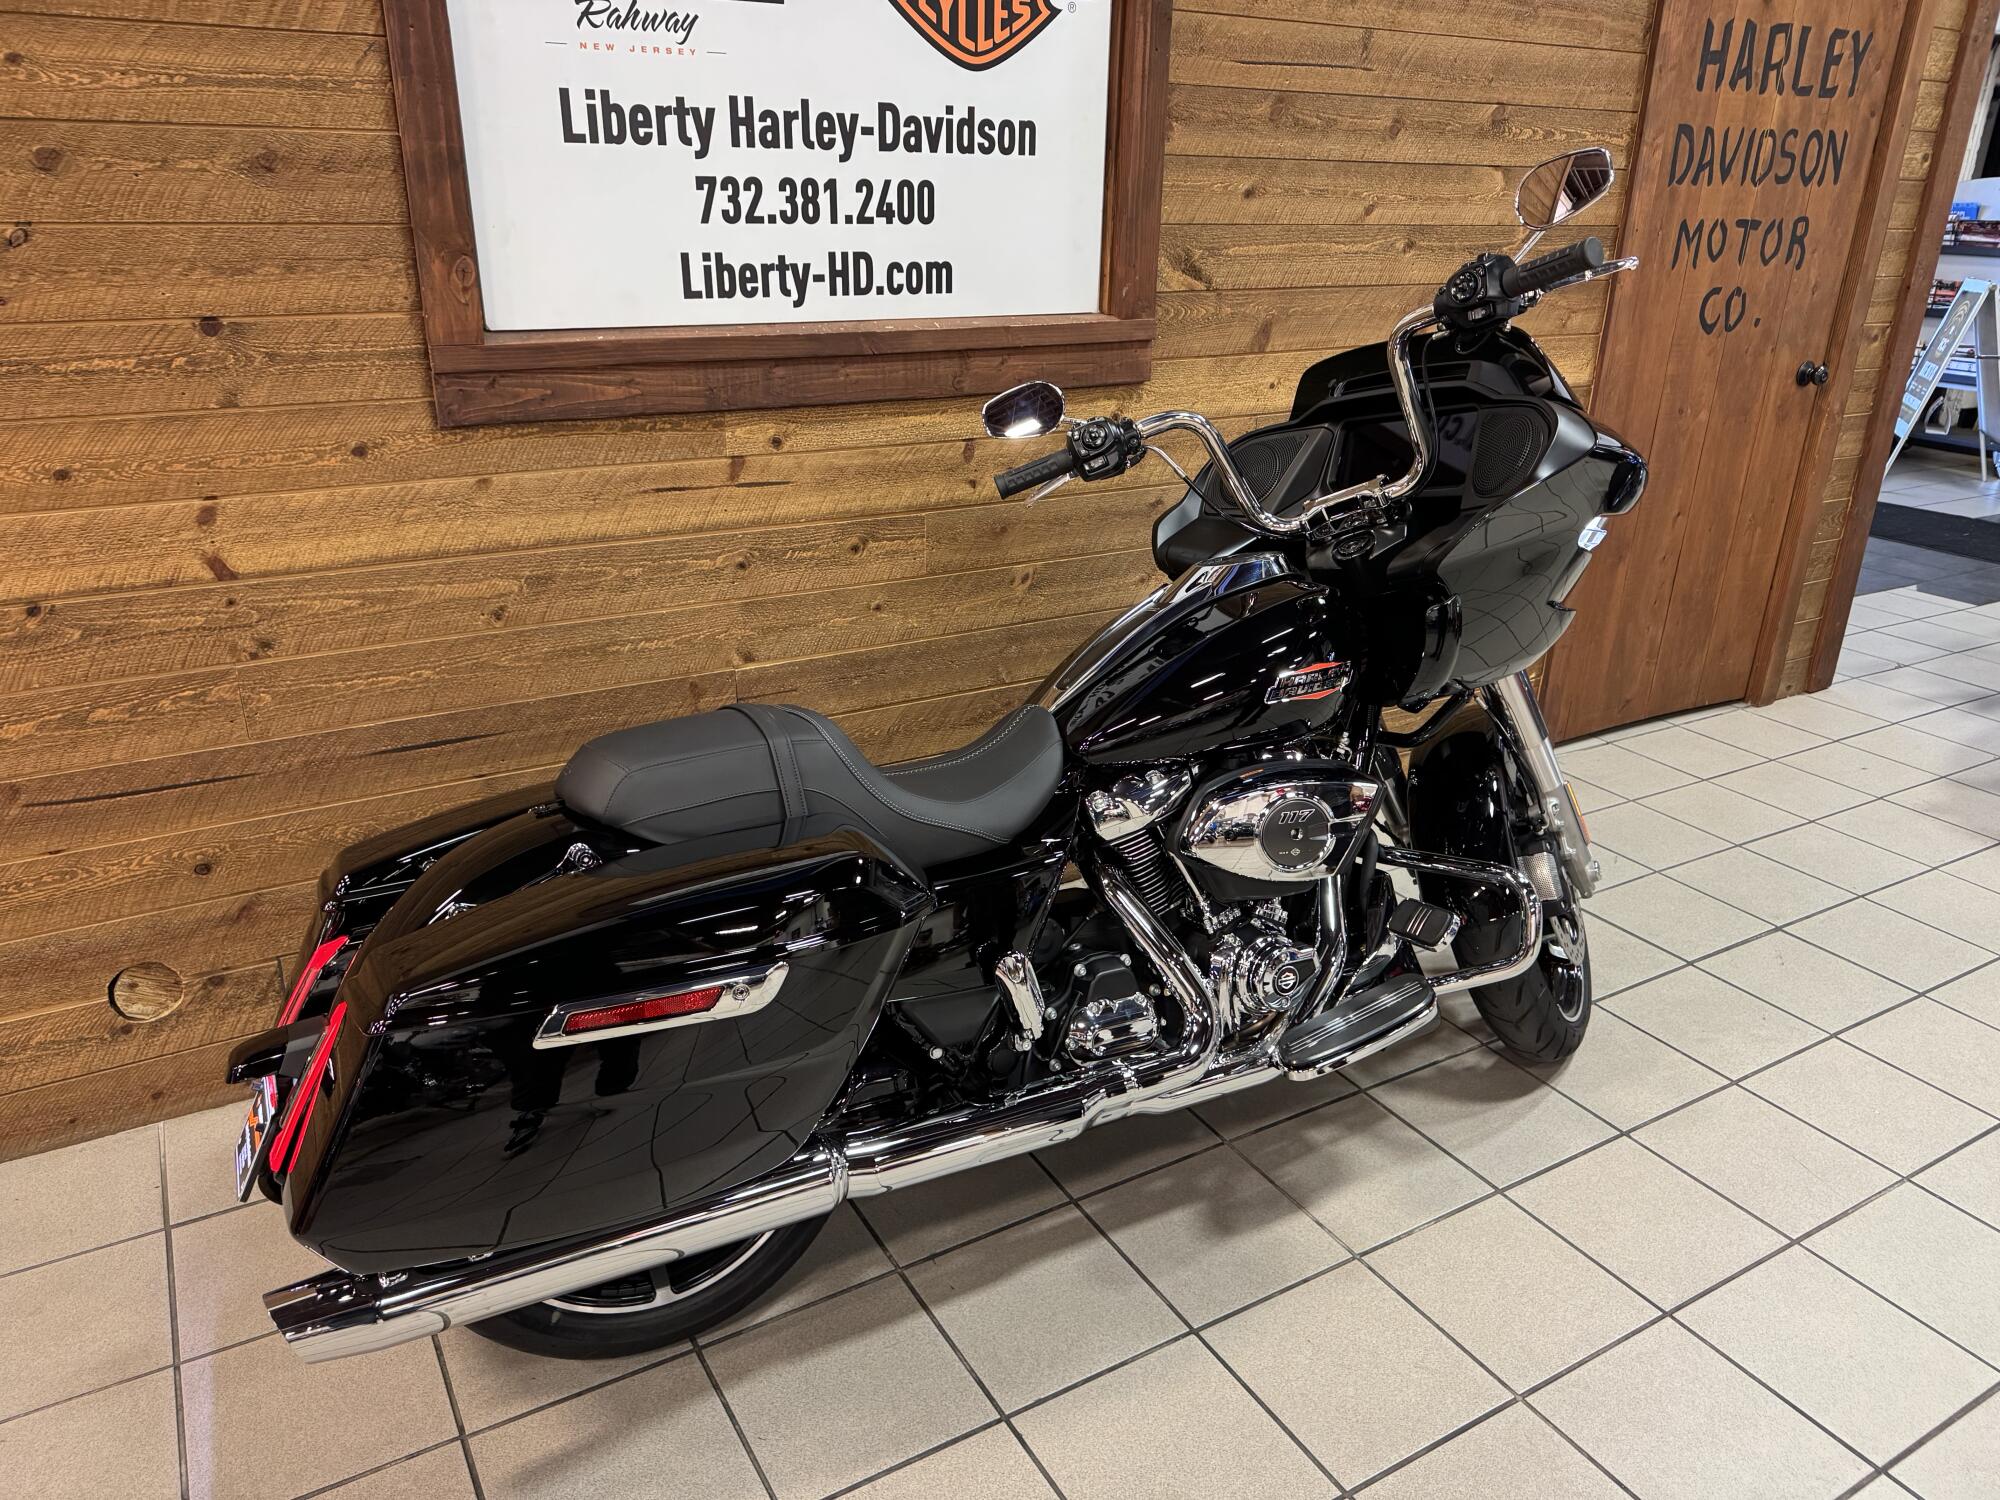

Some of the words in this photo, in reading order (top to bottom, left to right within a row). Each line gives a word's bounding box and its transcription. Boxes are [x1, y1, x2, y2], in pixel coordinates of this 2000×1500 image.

[574, 0, 700, 45] Rahway
[579, 42, 615, 51] NEW
[629, 45, 697, 56] JERSEY
[1696, 17, 1874, 99] HARLEY
[558, 87, 716, 160] Liberty
[728, 94, 1037, 163] Harley-Davidson
[1667, 123, 1849, 188] DAVIDSON
[695, 175, 935, 225] 732.381.2400
[1671, 216, 1810, 271] MOTOR
[680, 251, 953, 309] Liberty-HD.com
[1699, 286, 1762, 336] CO.
[1269, 677, 1346, 701] DAVID
[1278, 808, 1316, 825] 117
